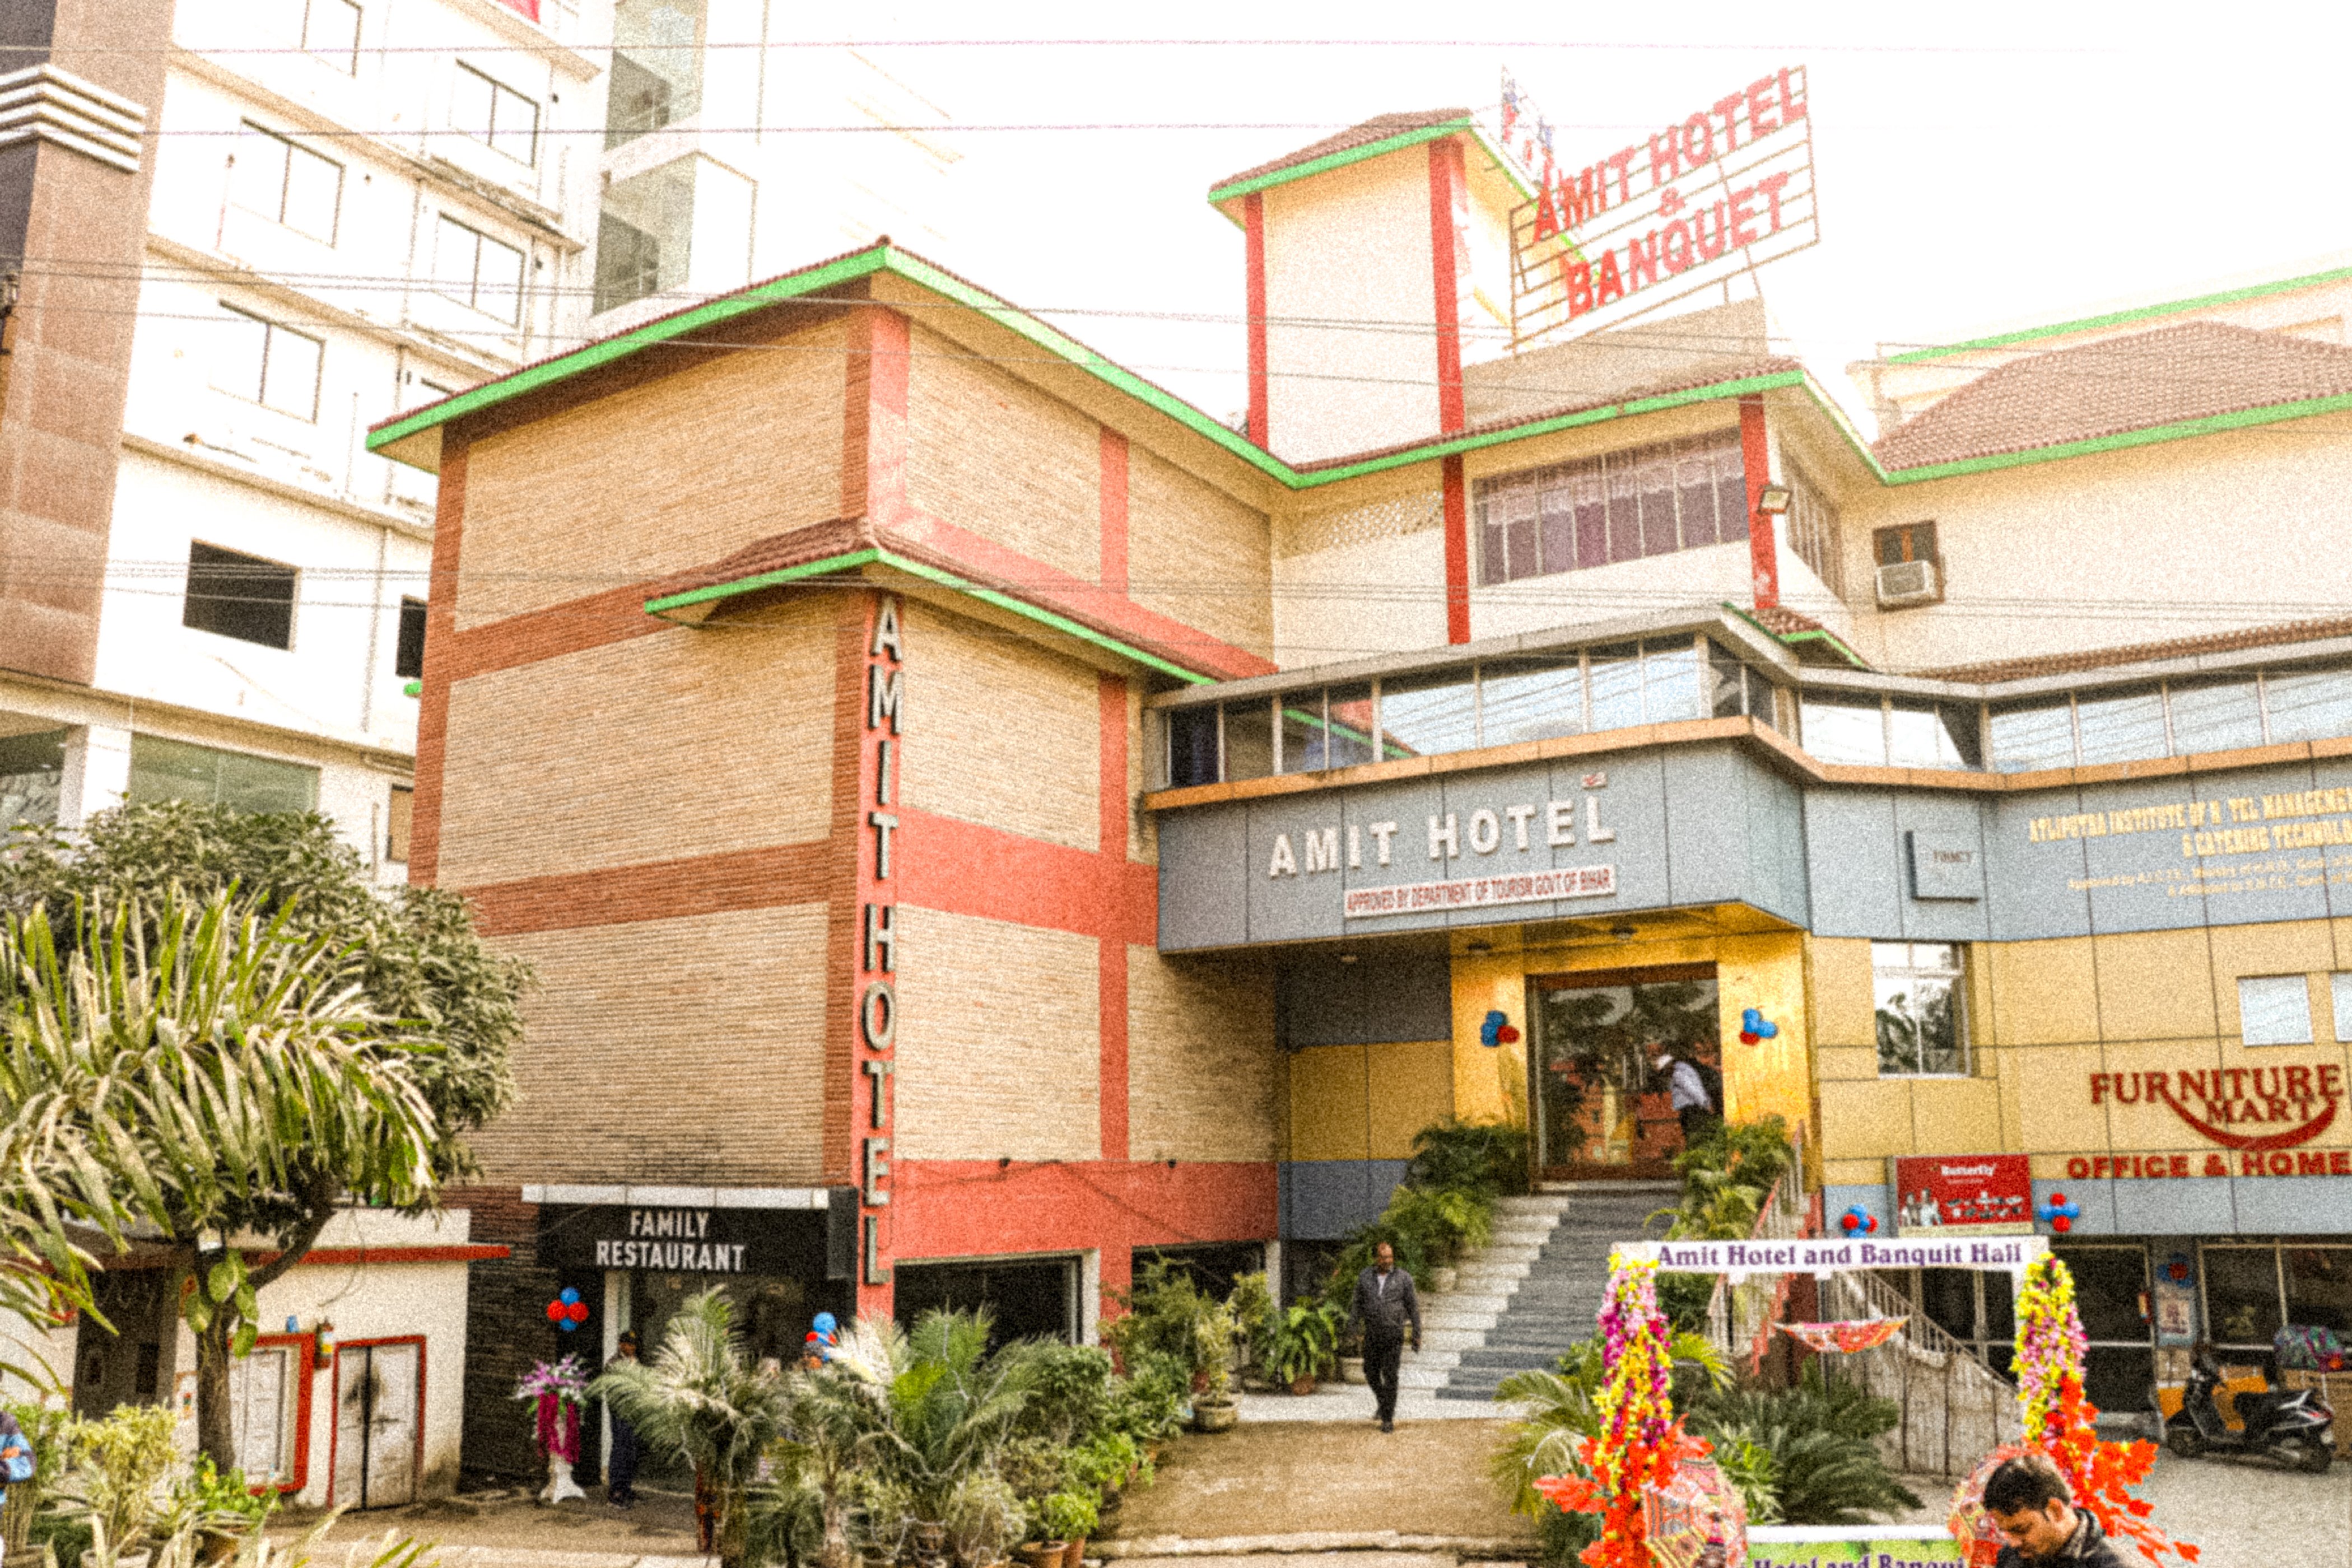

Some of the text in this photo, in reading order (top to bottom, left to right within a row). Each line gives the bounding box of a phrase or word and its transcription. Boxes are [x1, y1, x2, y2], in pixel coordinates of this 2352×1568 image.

[1533, 145, 1636, 242] AMIT
[1648, 67, 1808, 187] HOTEL
[1658, 188, 1685, 218] &
[1567, 171, 1789, 319] BANQUET
[1268, 795, 1616, 879] AMIT HOTEL
[1347, 889, 1394, 911] APPROVED
[1397, 888, 1408, 908] BY
[1411, 882, 1473, 907] DEPARTMENT
[1475, 880, 1488, 901] OF
[1491, 876, 1533, 900] TOURISM
[1564, 871, 1577, 894] OF
[1580, 867, 1611, 892] BIHAR
[861, 597, 903, 1285] AMIT HOTEL
[2090, 1064, 2344, 1104] FURNITURE
[2206, 1098, 2312, 1126] MART
[2067, 1151, 2352, 1179] OFFICE & HOME
[630, 1211, 709, 1238] FAMILY
[596, 1240, 745, 1271] RESTAURANT
[1659, 1245, 1719, 1266] Amit
[1727, 1244, 1796, 1266] Hotel
[1804, 1242, 1851, 1264] and
[1861, 1243, 1962, 1266] Banquit
